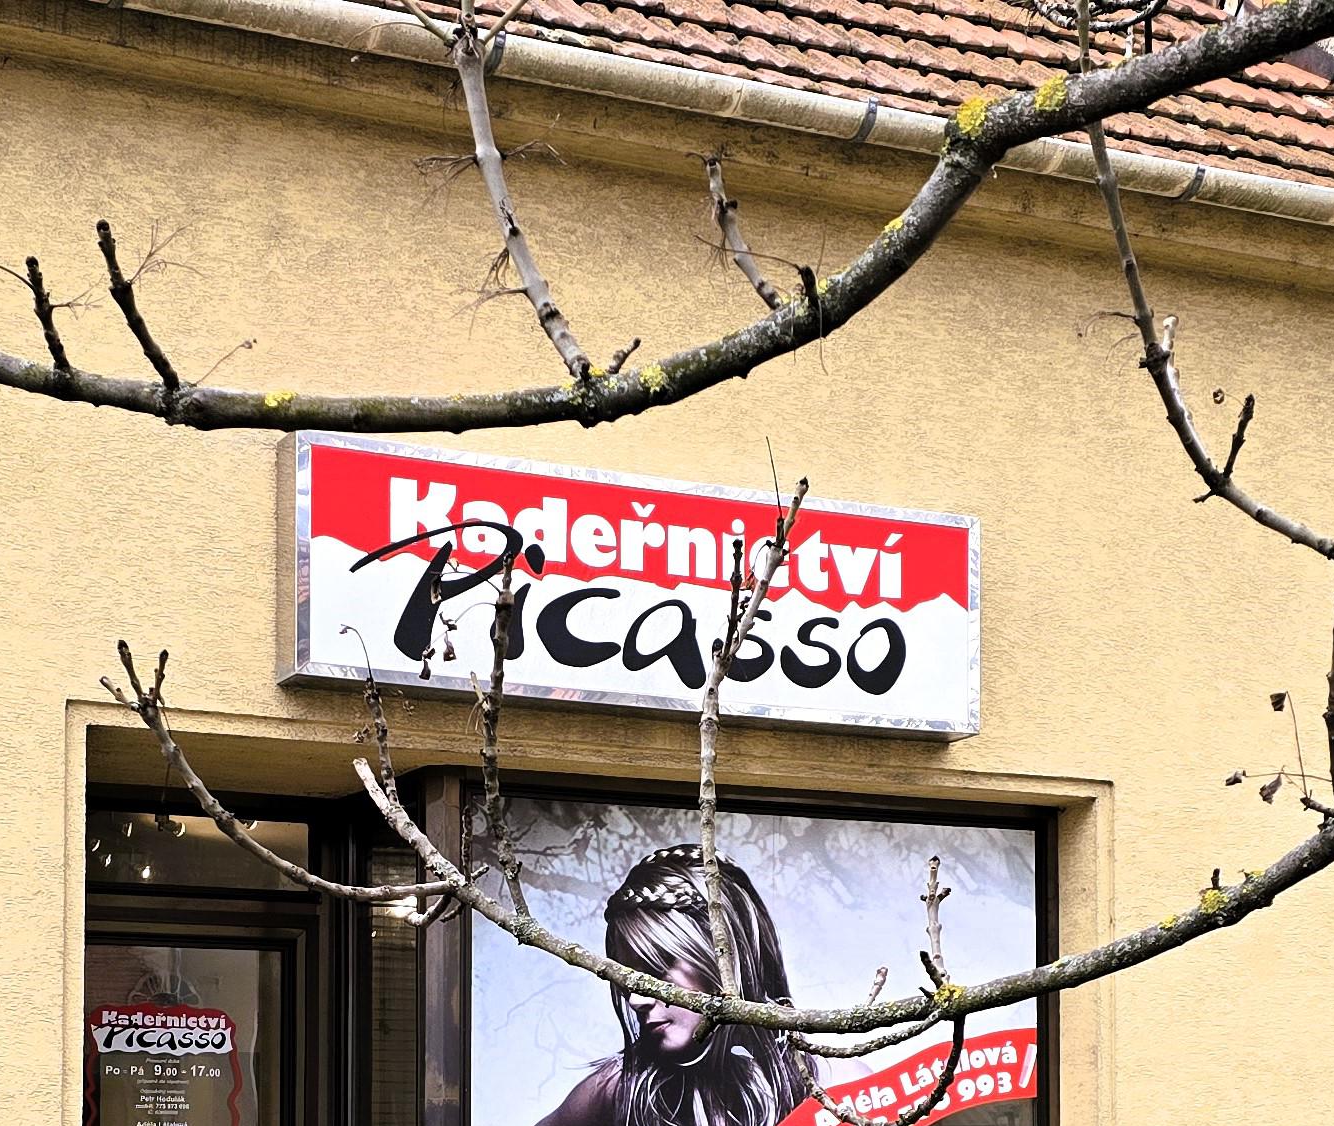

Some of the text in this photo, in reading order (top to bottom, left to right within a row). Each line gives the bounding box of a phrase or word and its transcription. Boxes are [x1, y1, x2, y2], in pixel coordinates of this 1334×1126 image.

[389, 477, 903, 599] Kadeřnictví
[349, 520, 907, 695] Picasso
[101, 1010, 226, 1029] Kadeřnictví
[94, 1024, 227, 1051] Picasso
[105, 1065, 120, 1075] Po
[130, 1065, 145, 1075] Pá
[154, 1064, 178, 1076] 9.00
[190, 1065, 221, 1077] 17.00
[900, 1041, 1018, 1096] Látlová
[957, 1071, 1014, 1103] 993
